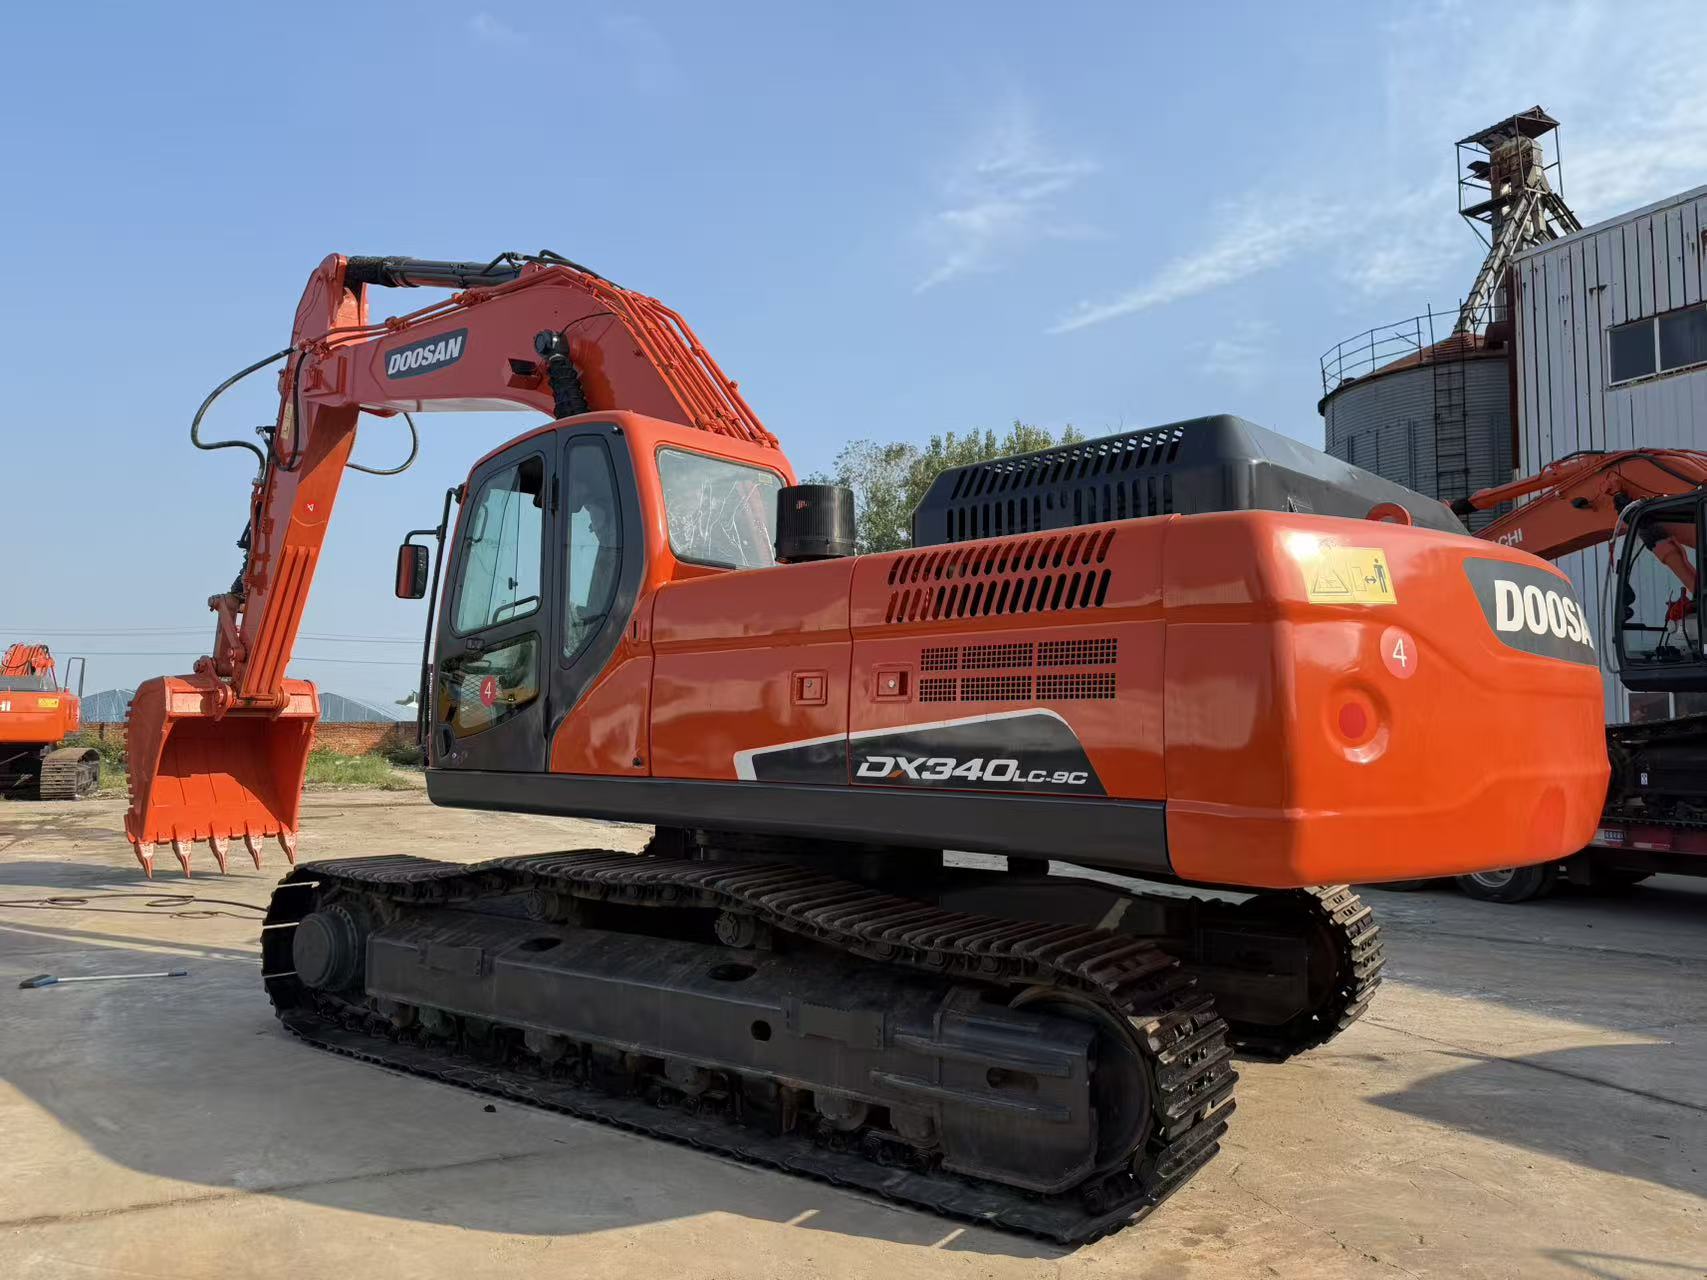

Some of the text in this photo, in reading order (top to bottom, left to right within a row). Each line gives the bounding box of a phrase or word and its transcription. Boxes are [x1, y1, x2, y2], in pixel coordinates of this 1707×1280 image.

[387, 336, 463, 375] DOOSAN
[1493, 528, 1523, 546] CHI
[1392, 638, 1408, 668] 4
[484, 681, 492, 699] 4
